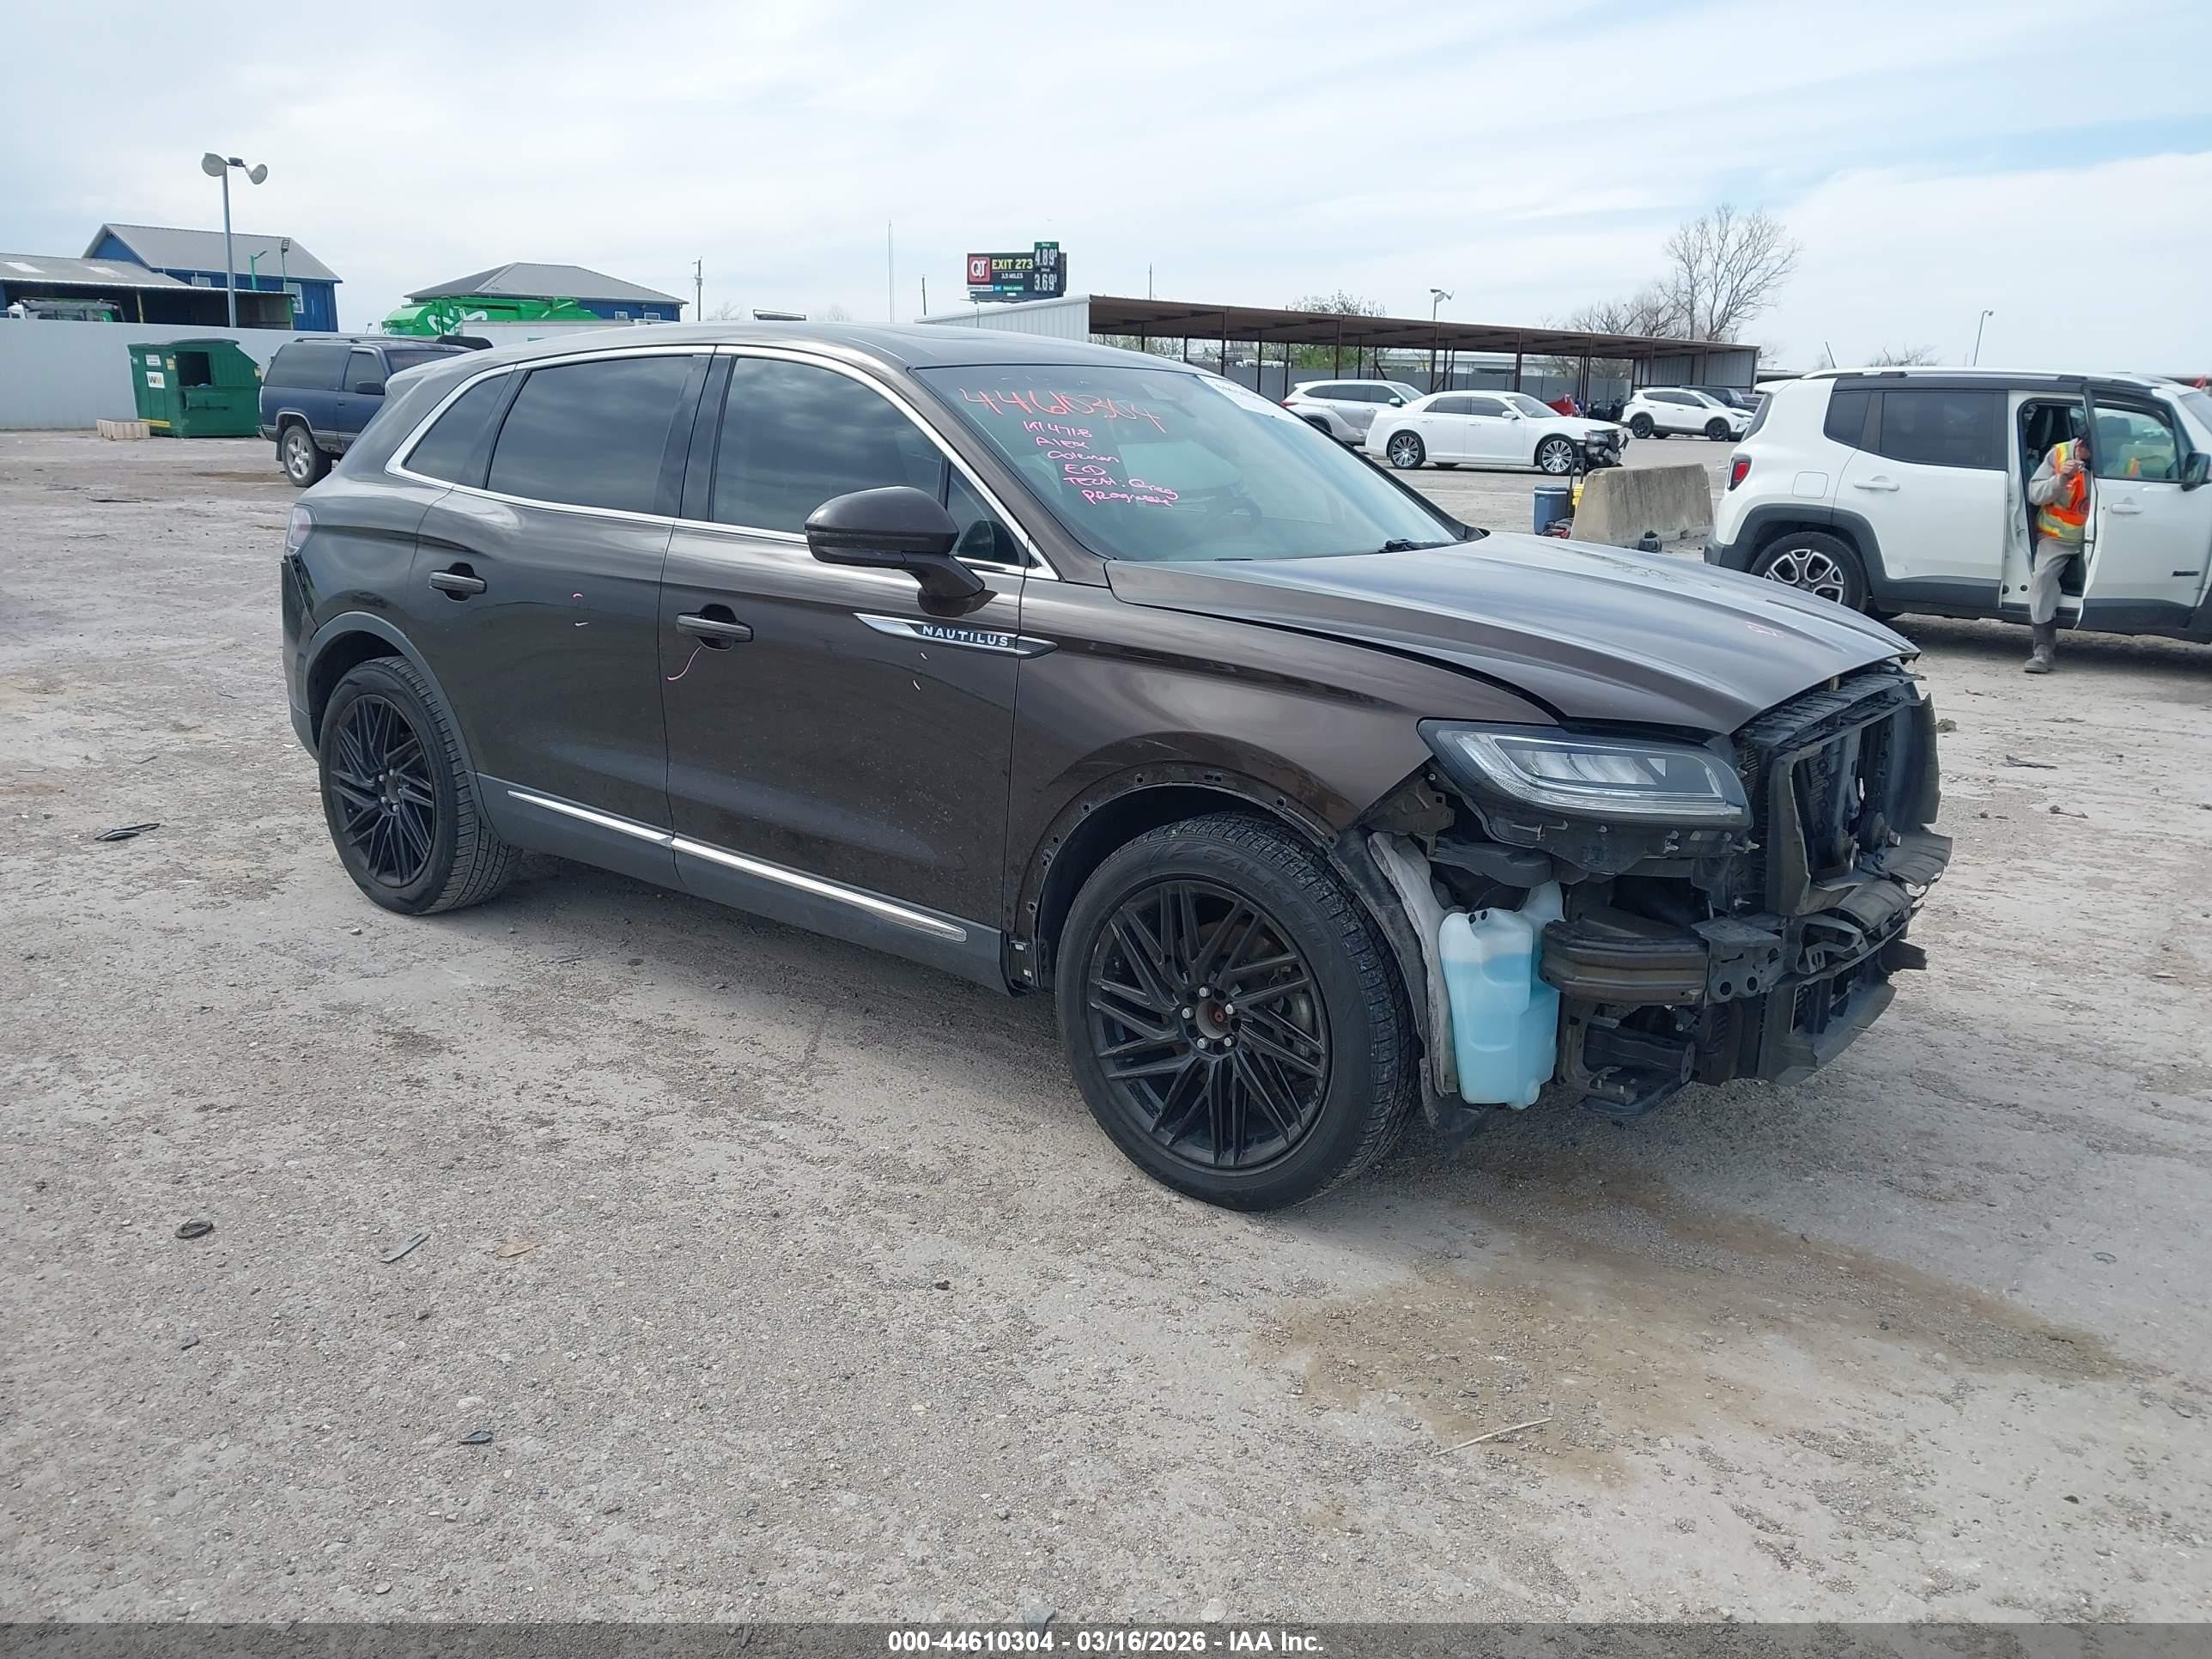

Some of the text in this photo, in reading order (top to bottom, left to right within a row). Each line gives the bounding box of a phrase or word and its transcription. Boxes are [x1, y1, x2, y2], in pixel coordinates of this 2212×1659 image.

[970, 260, 987, 278] QT
[992, 258, 1013, 270] EXIT
[1015, 258, 1034, 270] 273
[921, 624, 1009, 647] NAUTILUS
